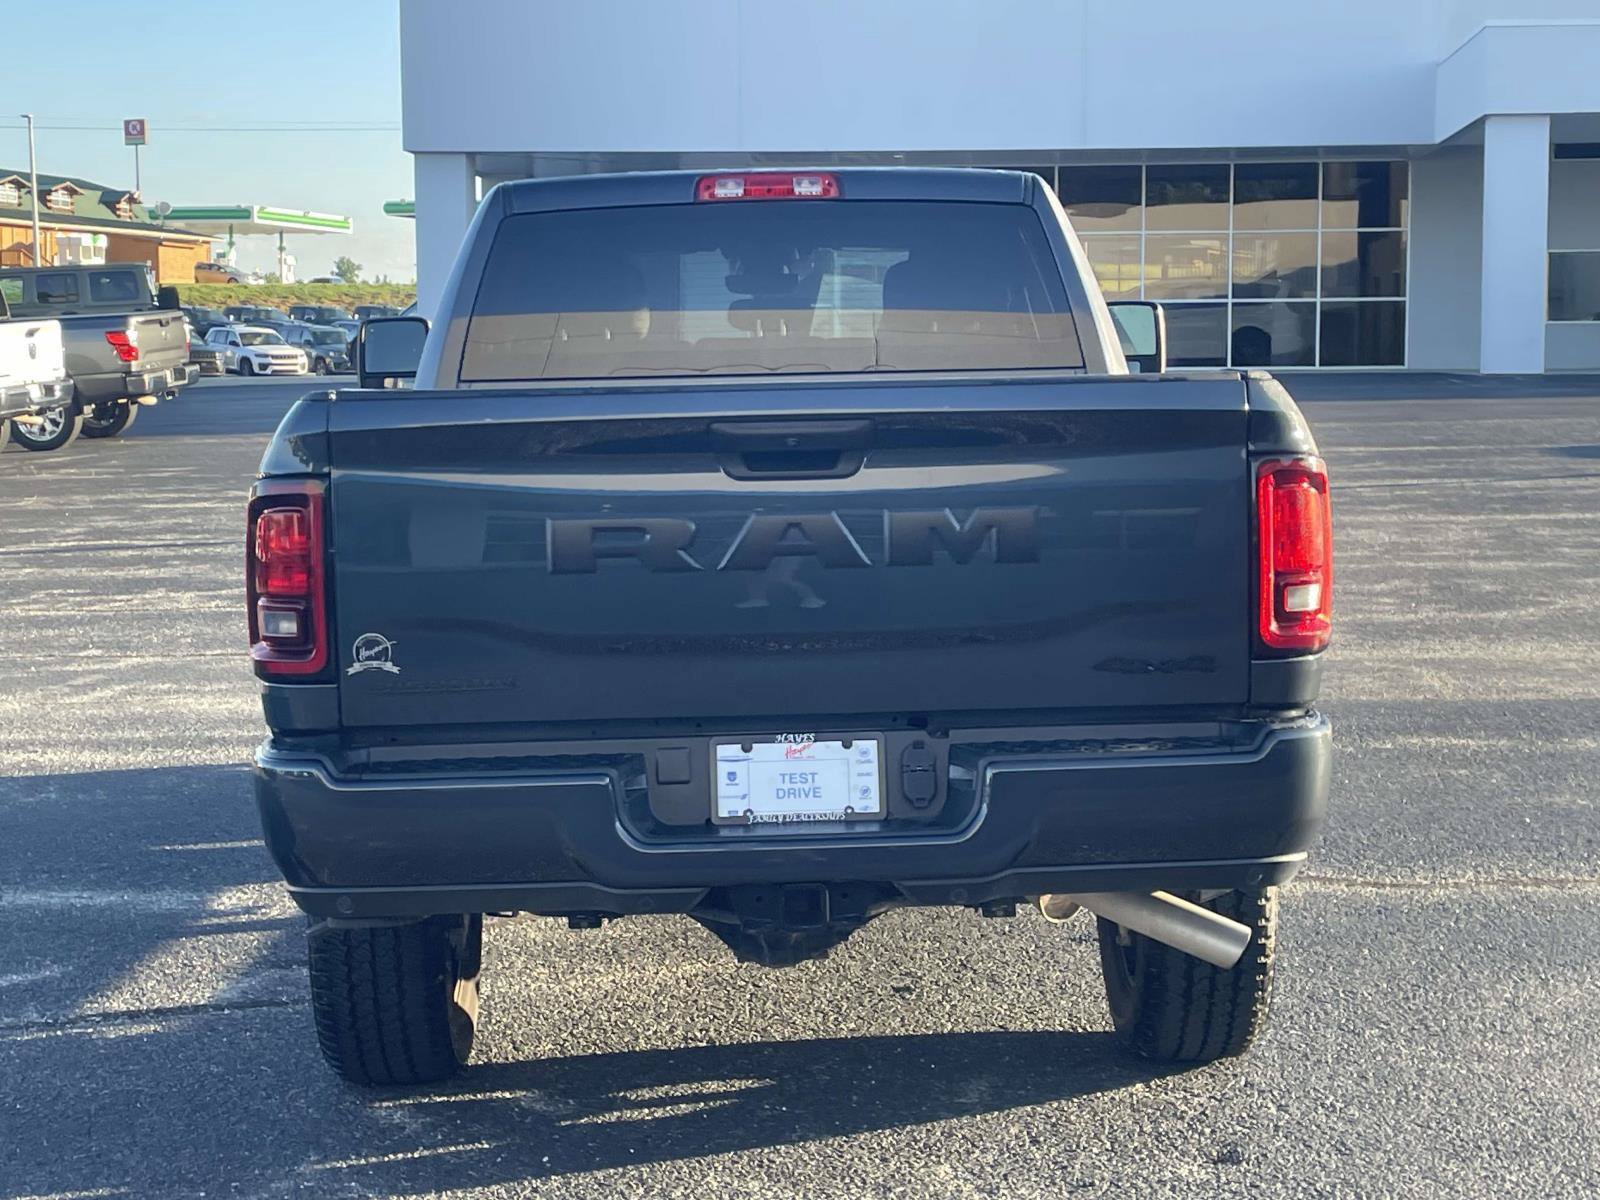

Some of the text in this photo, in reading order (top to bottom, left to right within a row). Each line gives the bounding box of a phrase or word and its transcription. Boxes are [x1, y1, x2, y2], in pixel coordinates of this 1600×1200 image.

[545, 506, 1041, 573] RAM
[775, 733, 816, 744] HAYES
[779, 772, 818, 784] TEST
[776, 787, 822, 799] DRIVE
